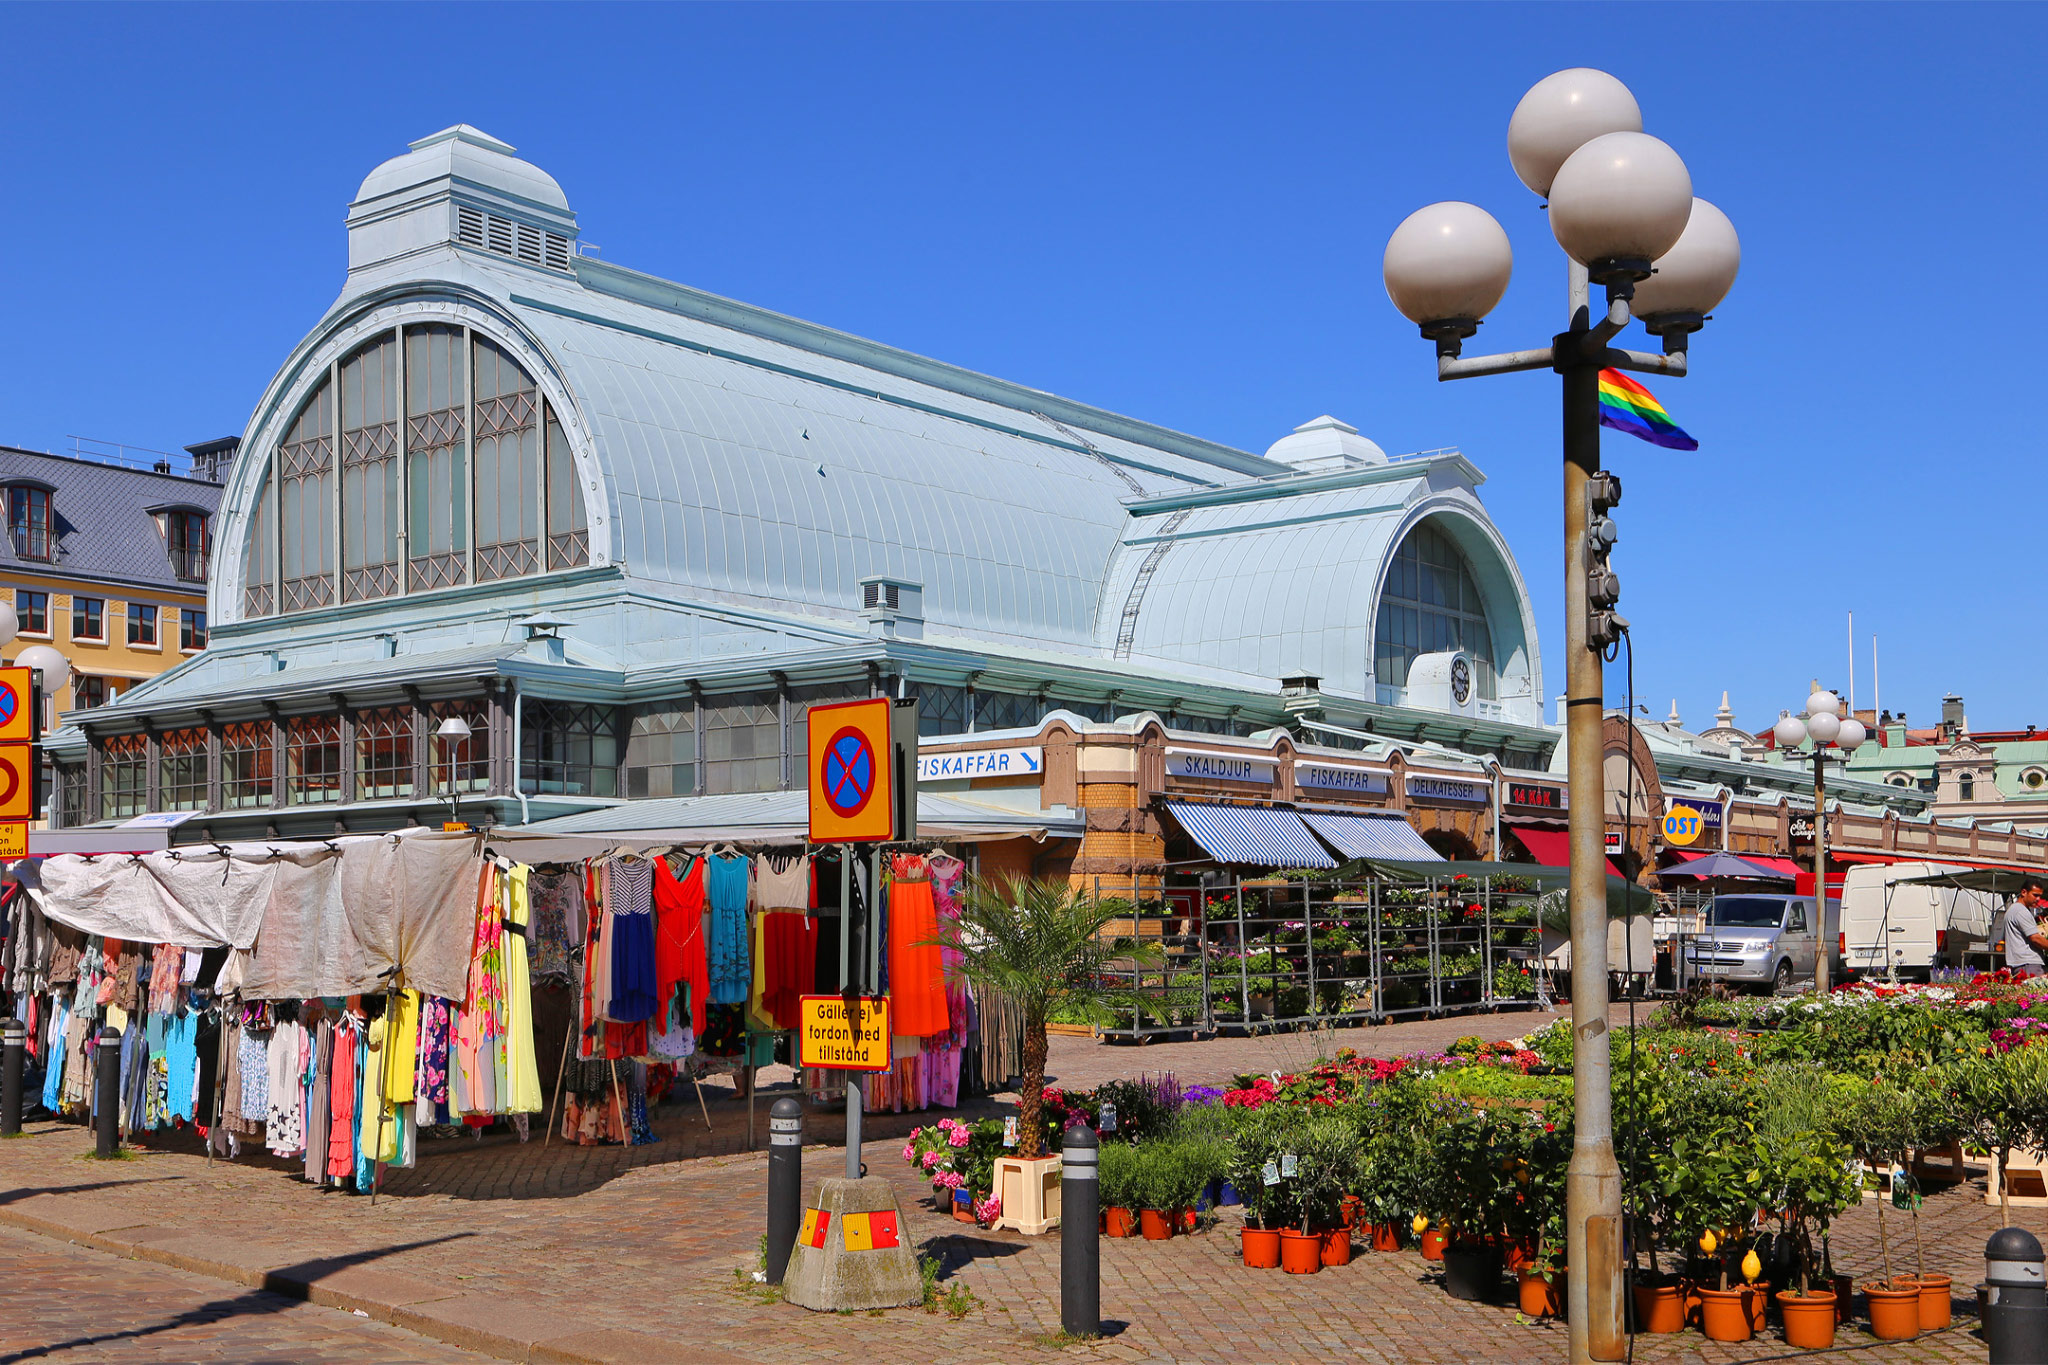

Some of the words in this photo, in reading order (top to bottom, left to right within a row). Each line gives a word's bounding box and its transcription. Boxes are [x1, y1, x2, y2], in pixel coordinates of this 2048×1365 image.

[1185, 755, 1251, 778] SKALDJUR
[1414, 779, 1474, 798] DELIKATESSER
[1513, 788, 1525, 804] 14
[1665, 817, 1698, 835] OST
[817, 1004, 855, 1019] Gäller
[859, 1005, 871, 1023] ej
[809, 1024, 849, 1040] fordon
[854, 1026, 880, 1041] med
[819, 1045, 869, 1062] tillstånd
